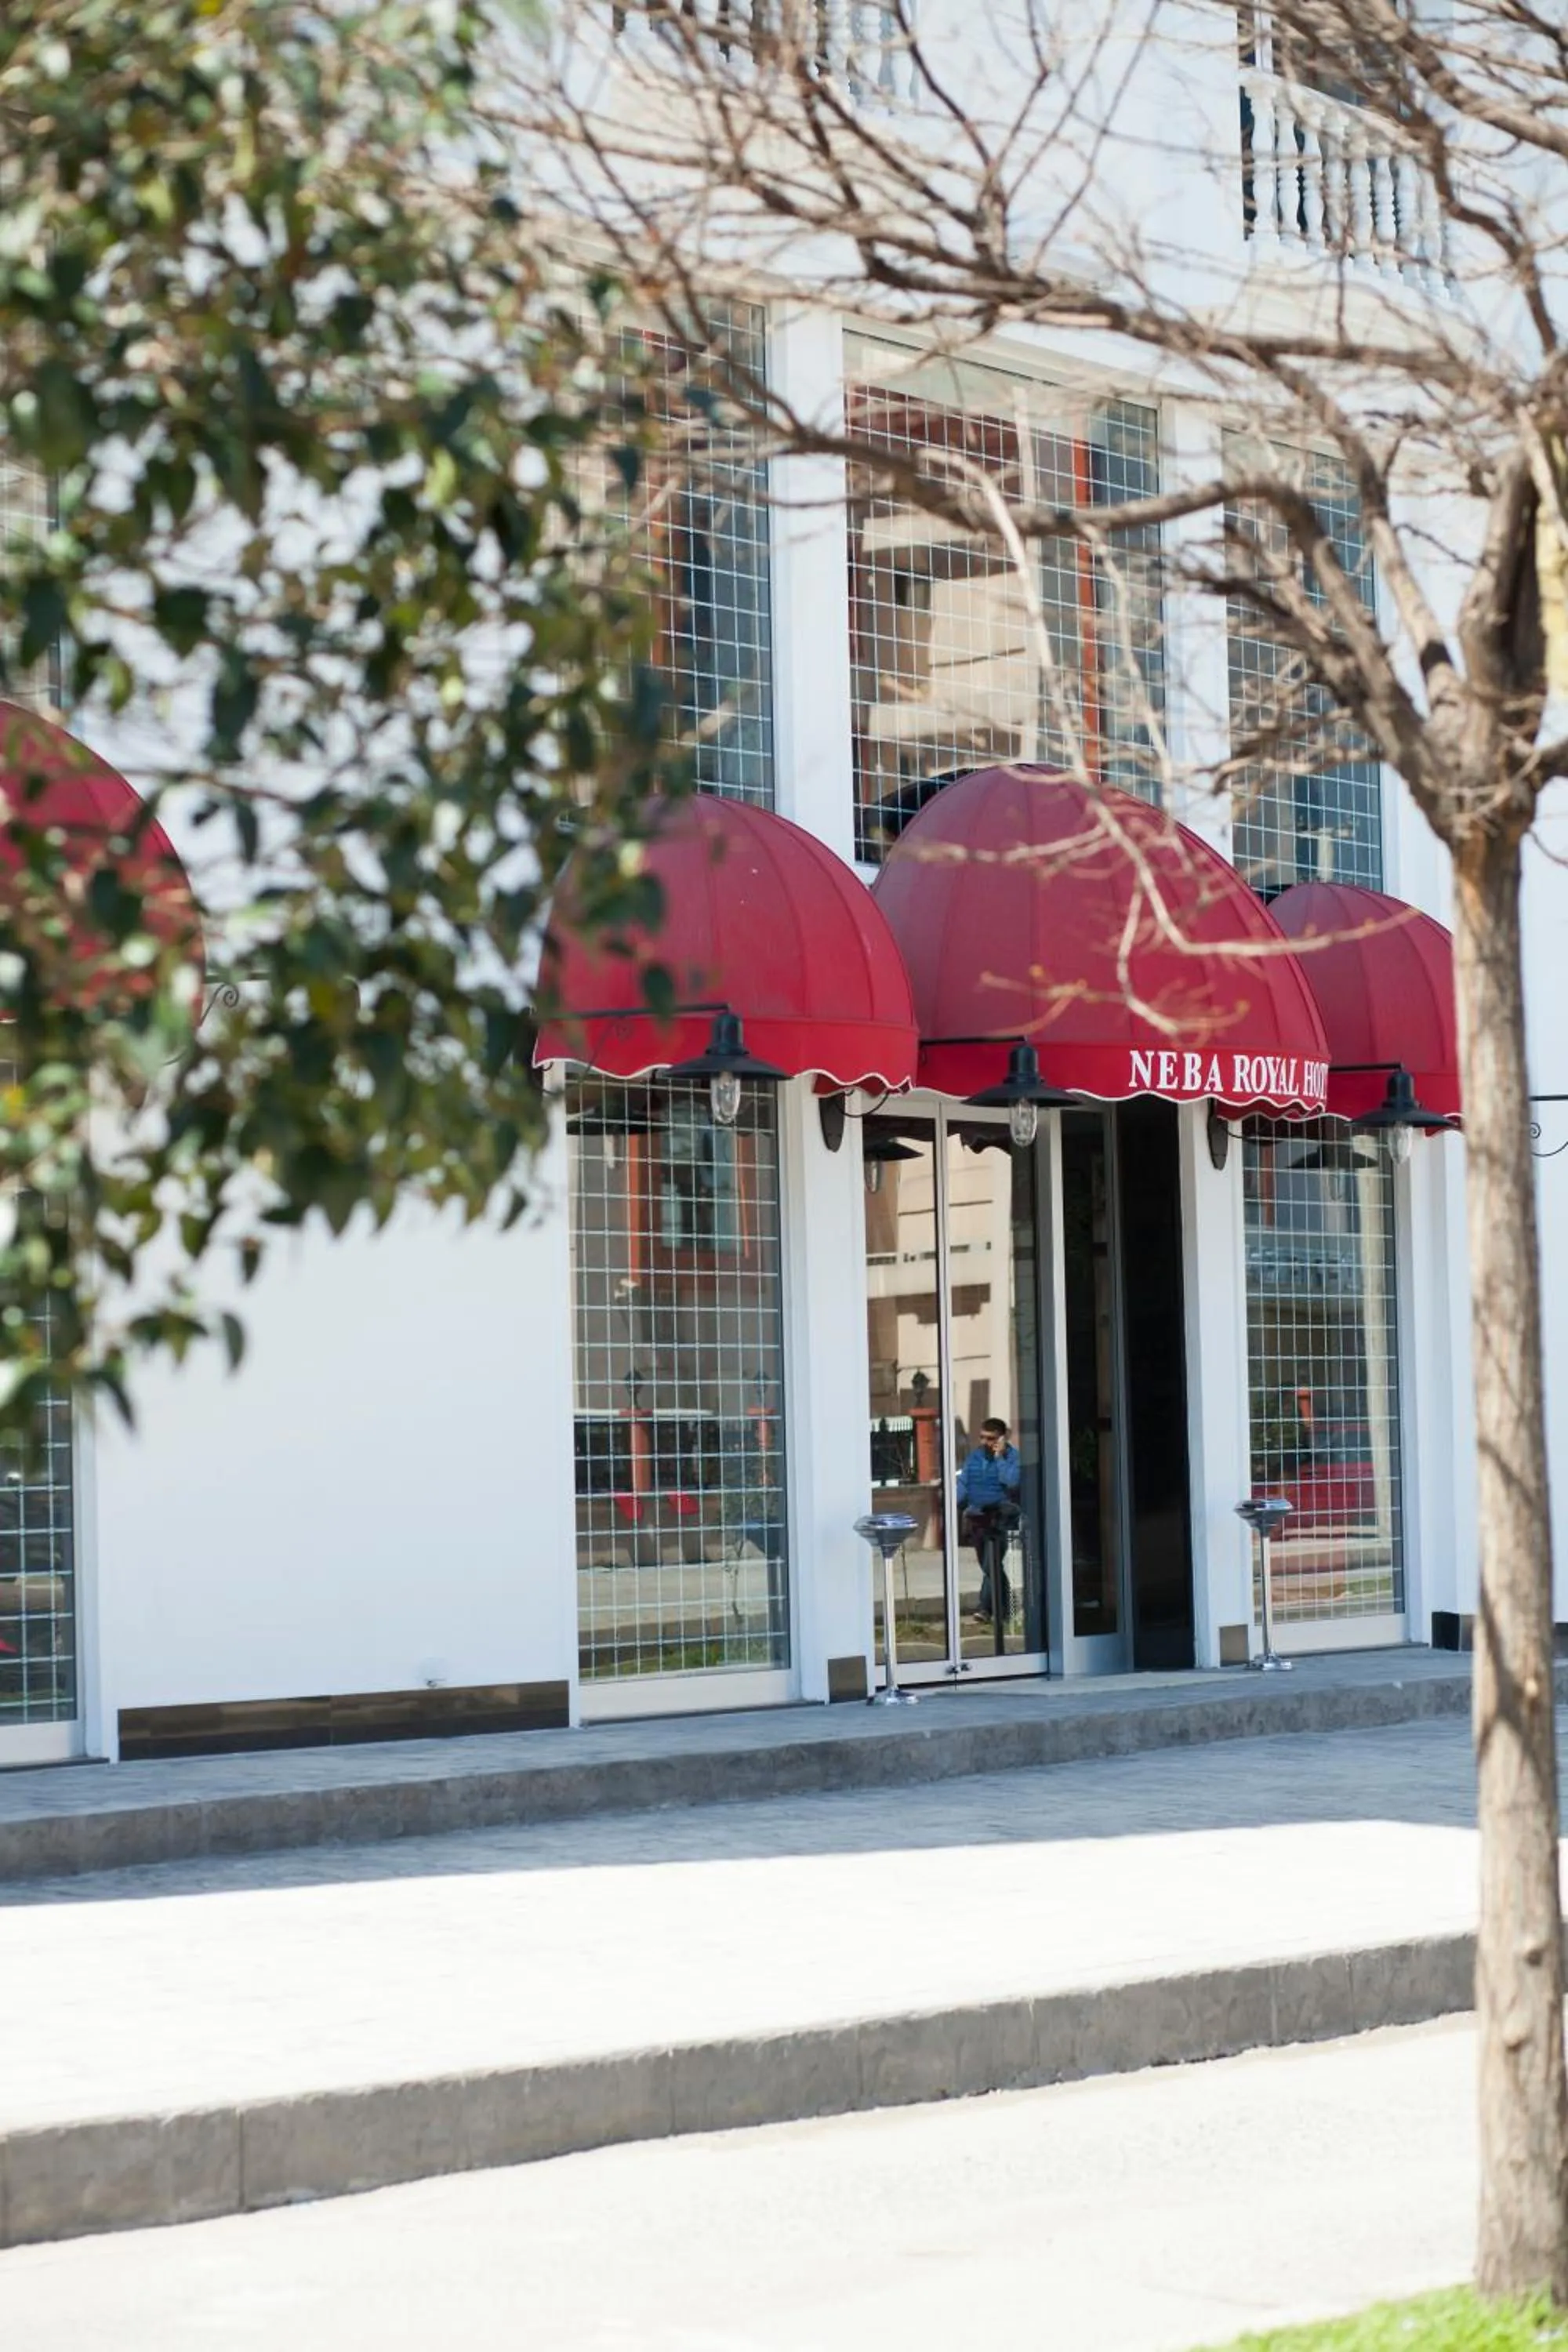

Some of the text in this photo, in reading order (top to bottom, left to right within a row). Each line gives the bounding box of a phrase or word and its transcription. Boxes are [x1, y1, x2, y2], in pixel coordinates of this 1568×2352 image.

[1129, 1050, 1329, 1100] NEBA ROYAL HOT
